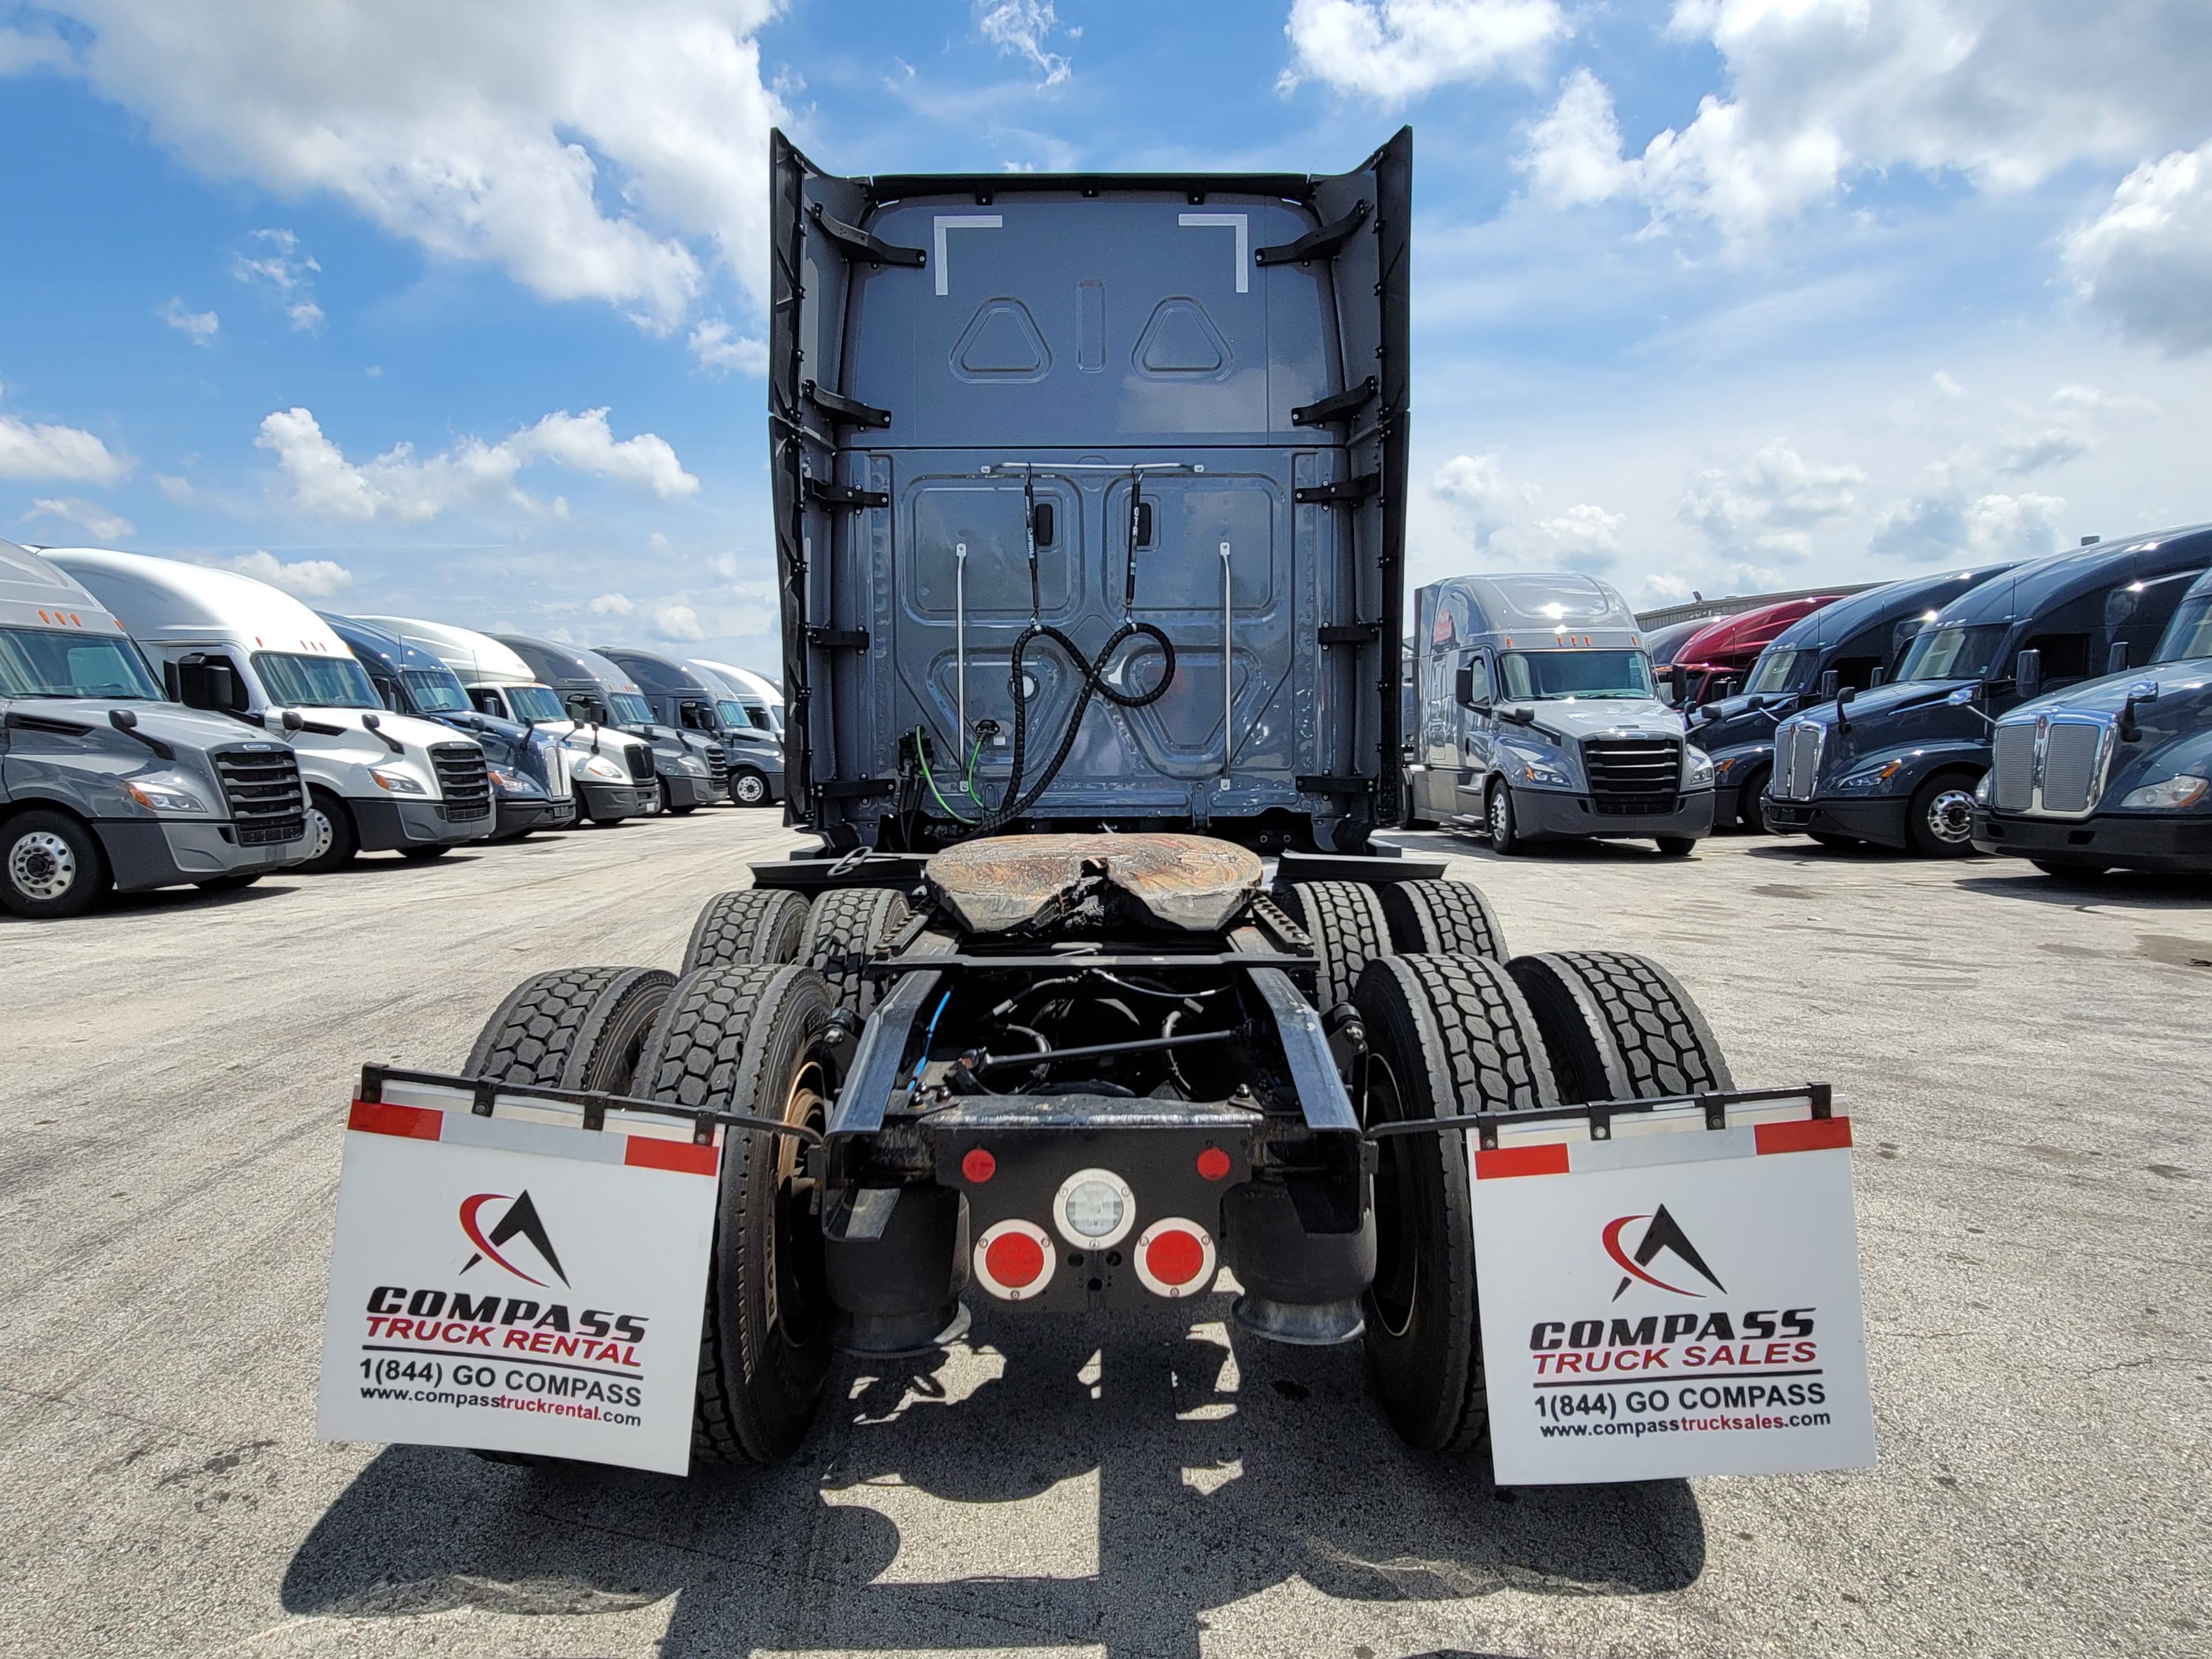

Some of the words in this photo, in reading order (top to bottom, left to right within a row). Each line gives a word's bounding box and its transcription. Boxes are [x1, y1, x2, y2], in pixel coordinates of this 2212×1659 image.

[366, 1286, 650, 1343] COMPASS
[1529, 1307, 1817, 1351] COMPASS
[366, 1316, 496, 1347] TRUCK
[502, 1329, 642, 1368] RENTAL
[1533, 1347, 1671, 1374] TRUCK
[1681, 1341, 1817, 1367] SALES
[359, 1358, 443, 1389] 1(844)
[452, 1365, 496, 1388] GO
[505, 1370, 642, 1408] COMPASS
[1535, 1392, 1617, 1422] 1(844)
[1626, 1389, 1669, 1414] GO
[1679, 1382, 1825, 1410] COMPASS
[360, 1387, 641, 1427] www.compasstruckrental.com
[1540, 1412, 1831, 1438] www.compasstrucksales.com
